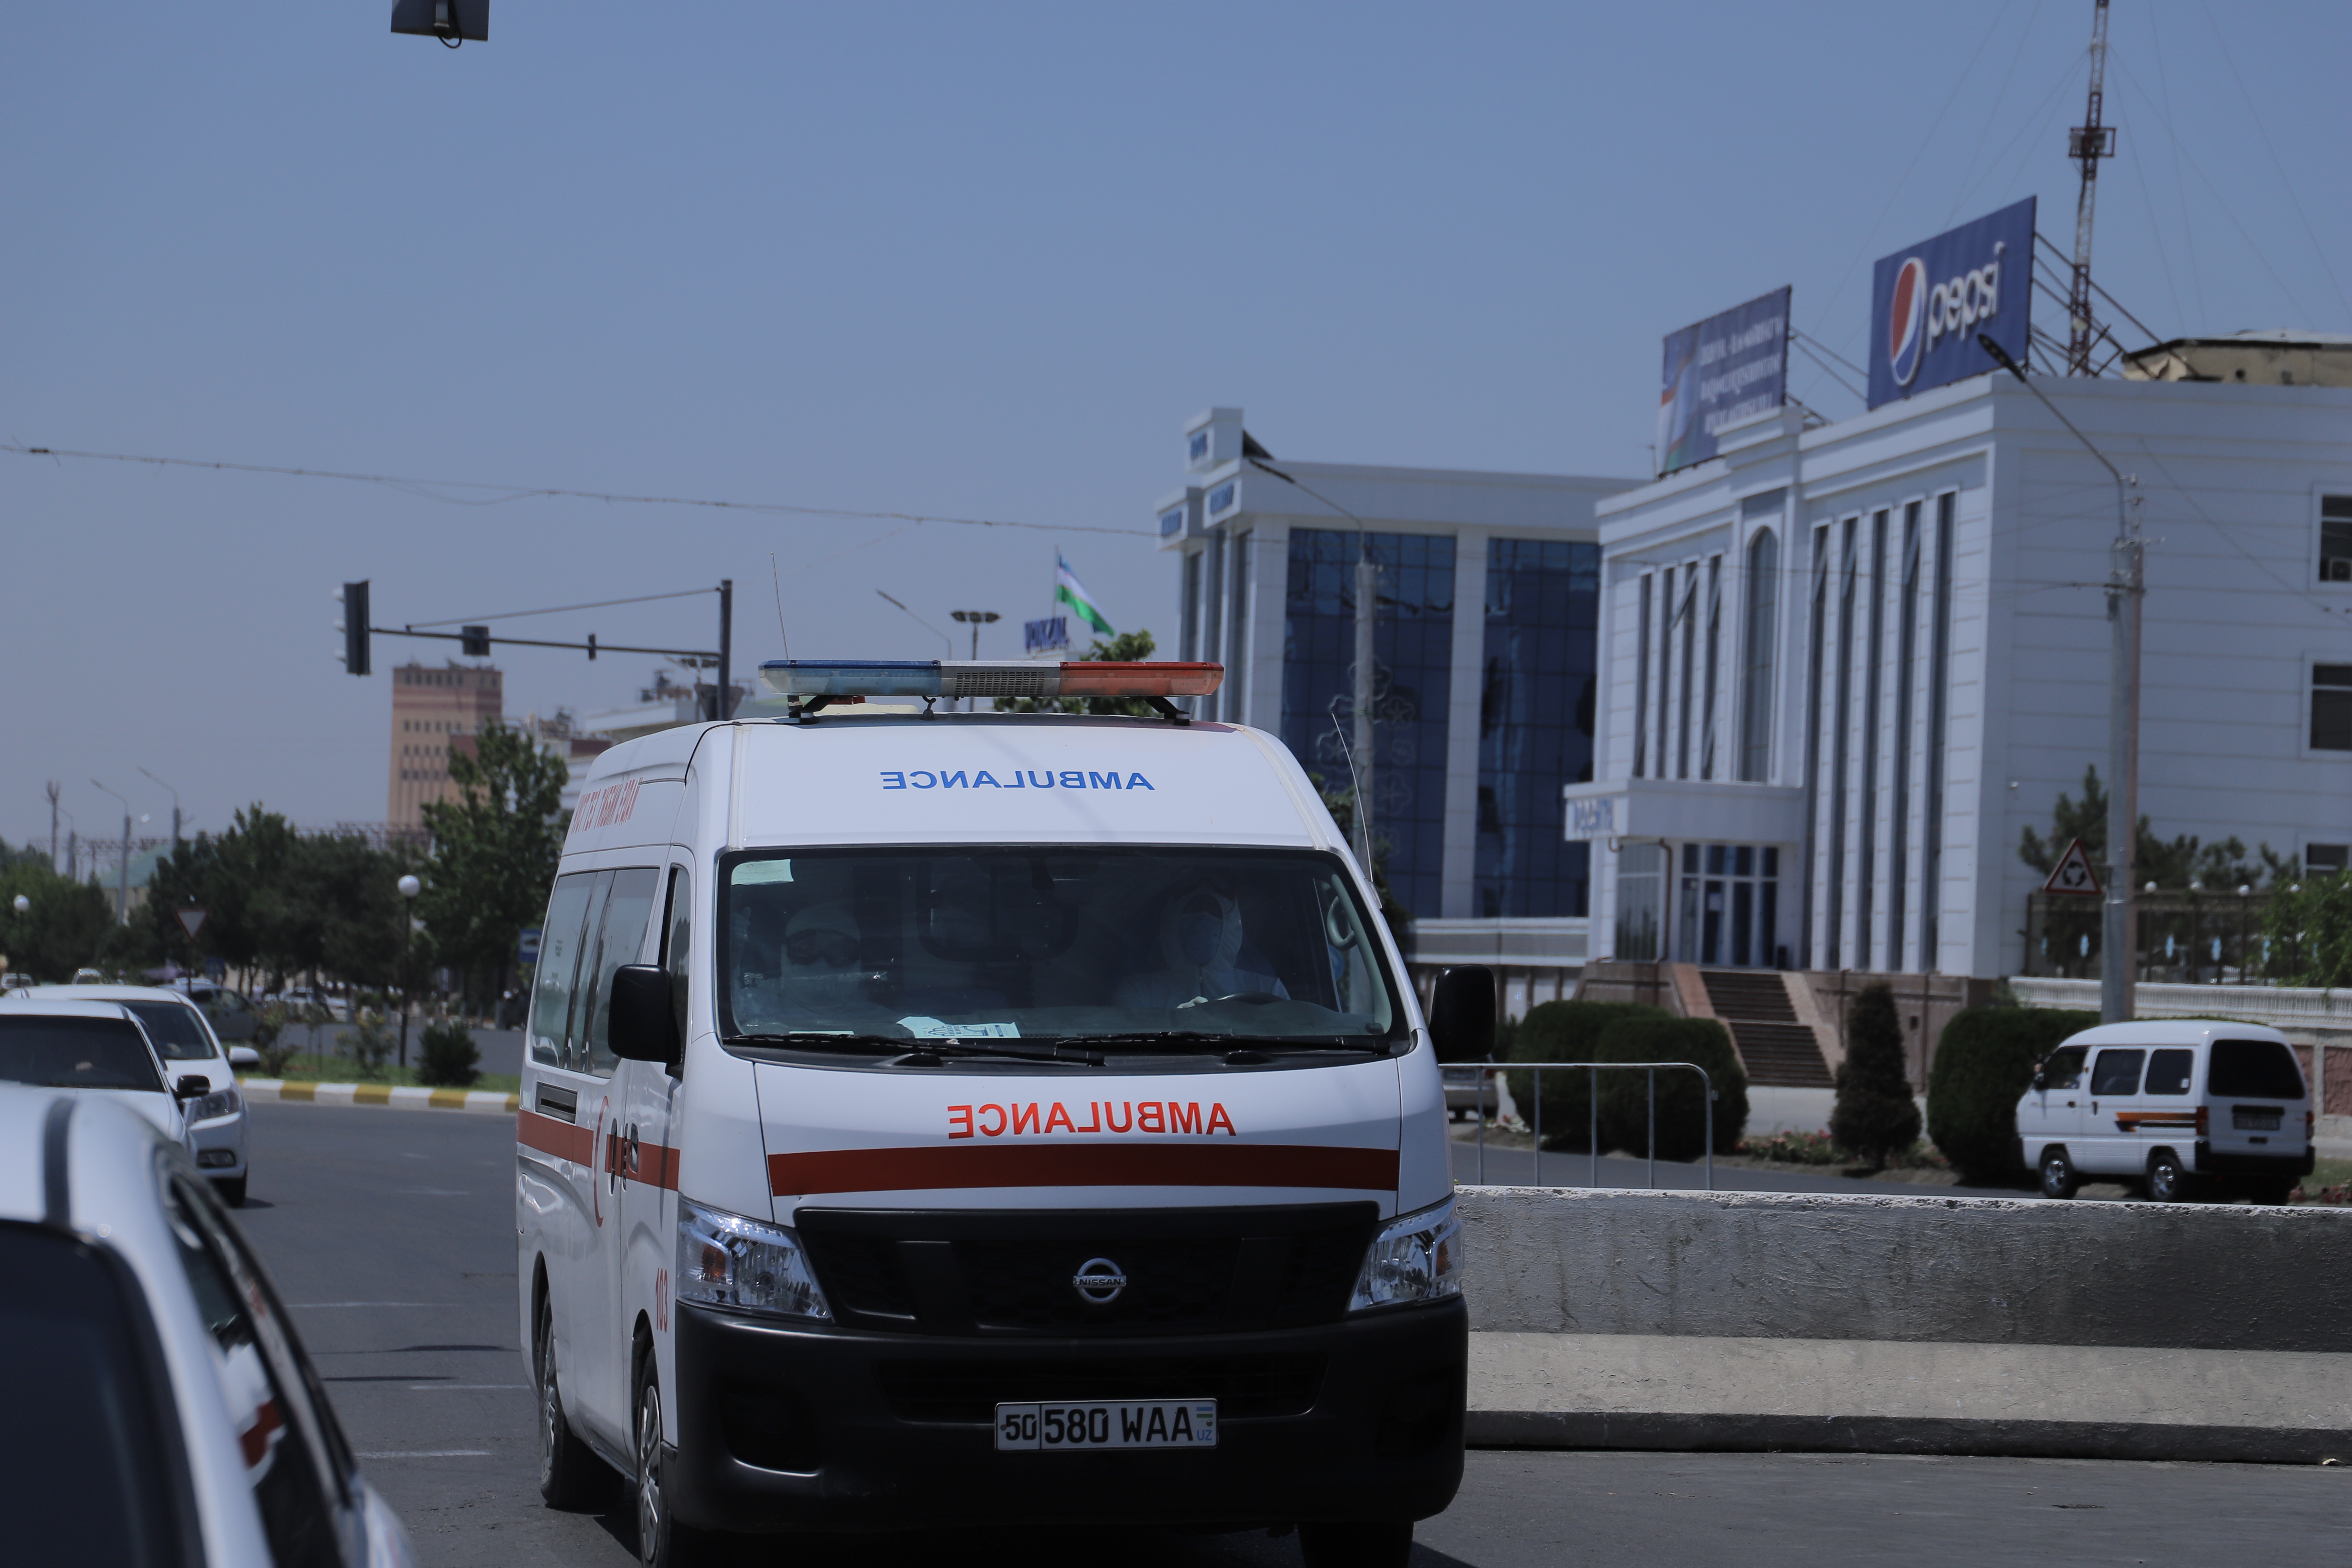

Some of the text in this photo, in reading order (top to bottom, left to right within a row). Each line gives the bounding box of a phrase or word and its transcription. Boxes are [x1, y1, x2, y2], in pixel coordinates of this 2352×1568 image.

[1927, 240, 2004, 353] pepsi
[655, 1267, 669, 1334] 103
[1006, 1407, 1193, 1444] 50 580 WAA
[1197, 1429, 1213, 1441] UZ
